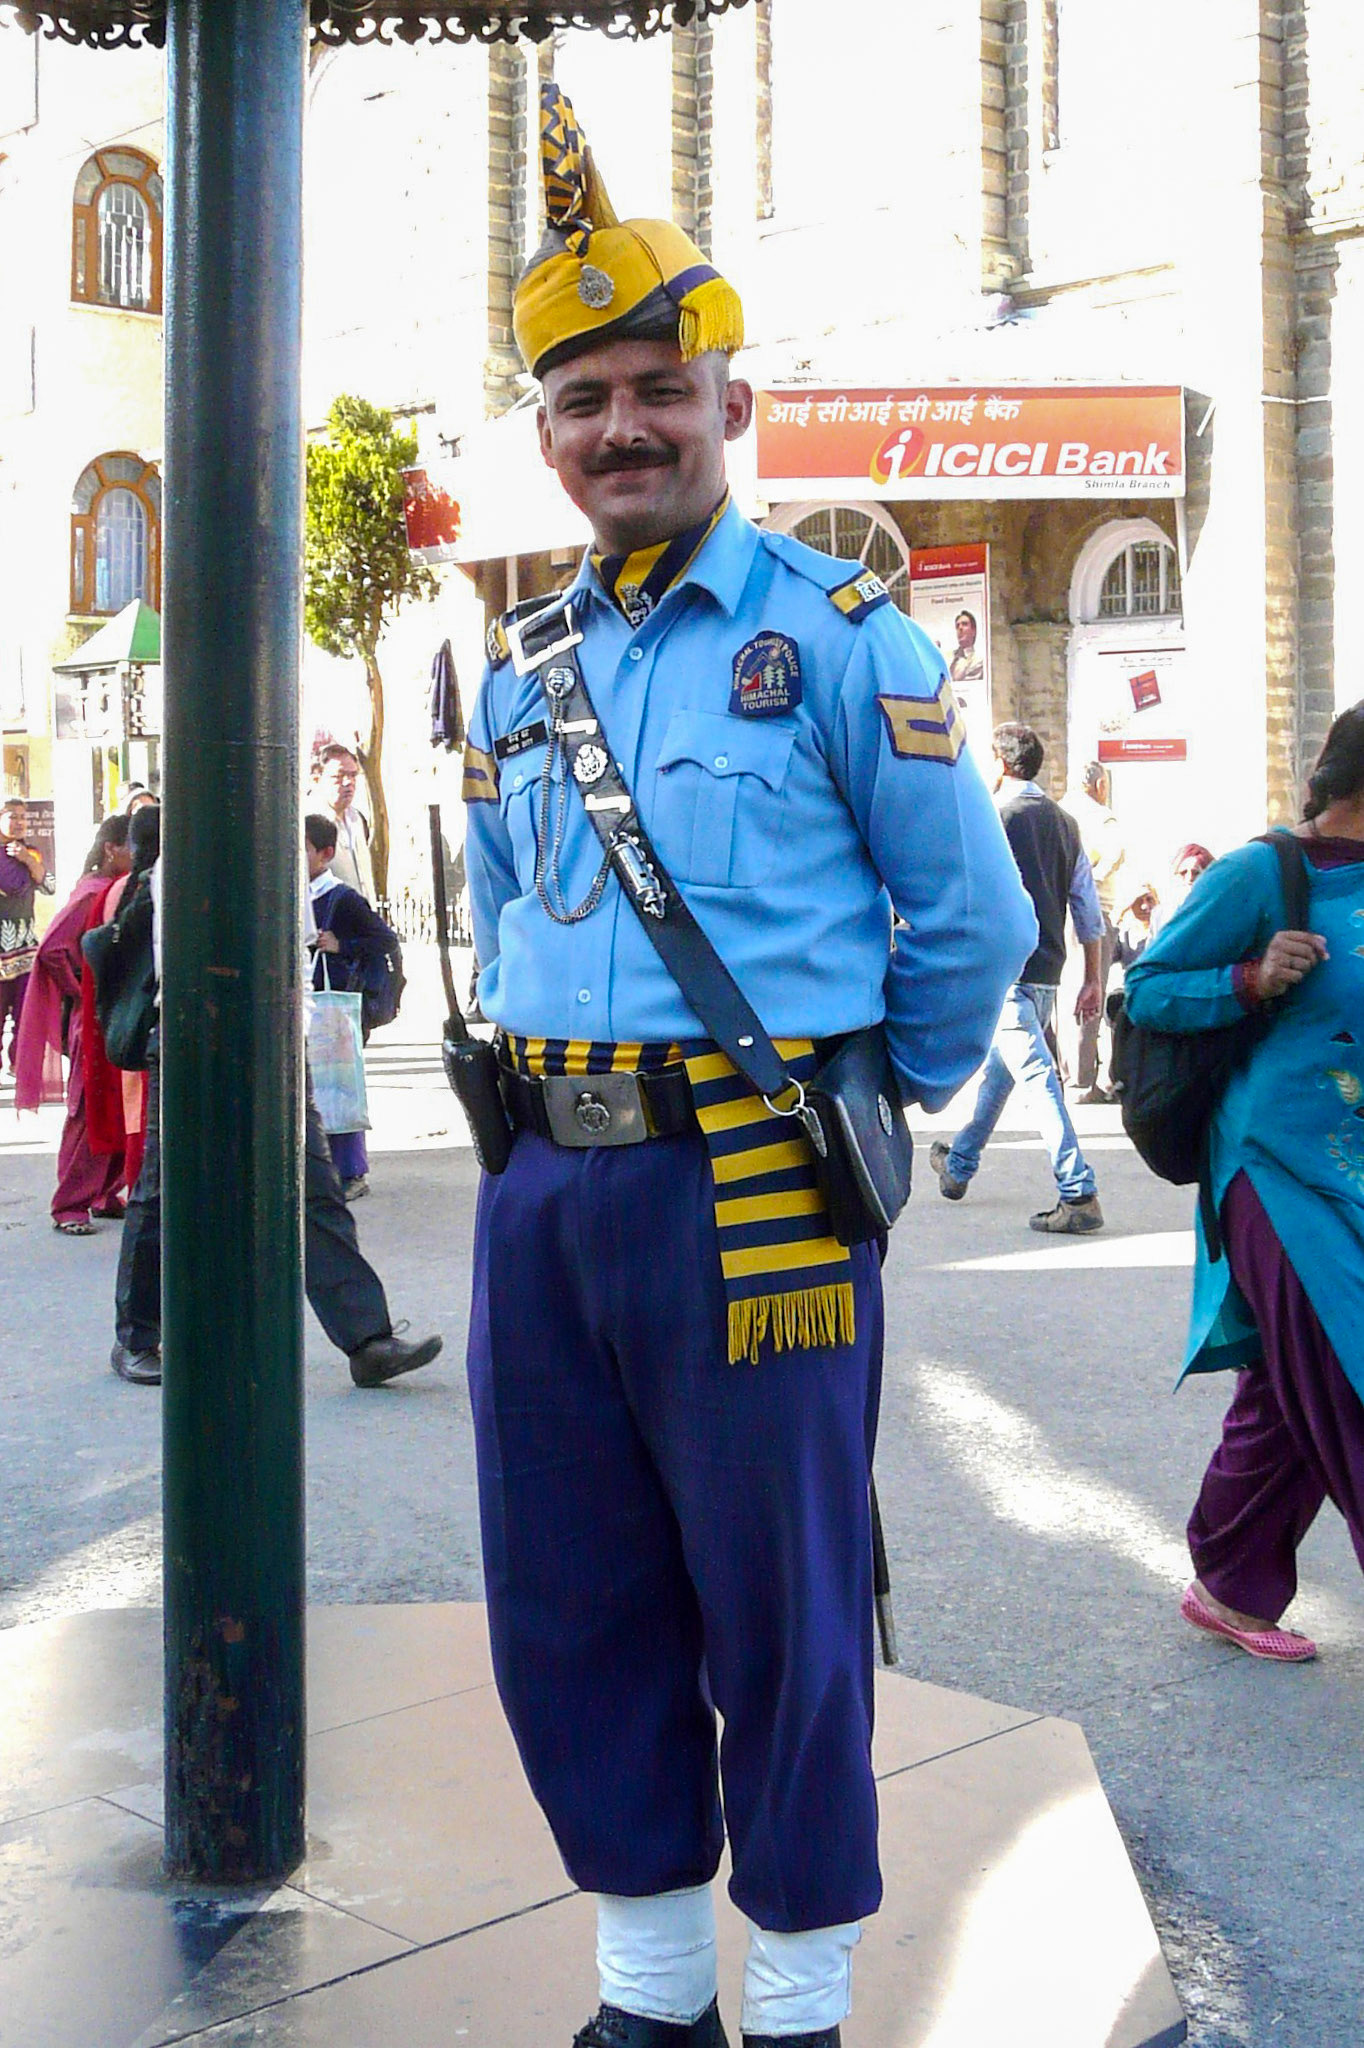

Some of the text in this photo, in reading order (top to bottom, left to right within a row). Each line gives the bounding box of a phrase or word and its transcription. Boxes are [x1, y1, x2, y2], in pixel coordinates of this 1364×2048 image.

[984, 394, 1022, 421] बैंक
[924, 443, 1048, 476] ICICI
[1055, 442, 1170, 475] Bank
[1085, 480, 1171, 489] Shimla Branch
[781, 642, 800, 678] POLICE
[740, 688, 792, 711] HIMACHAL TOURISM
